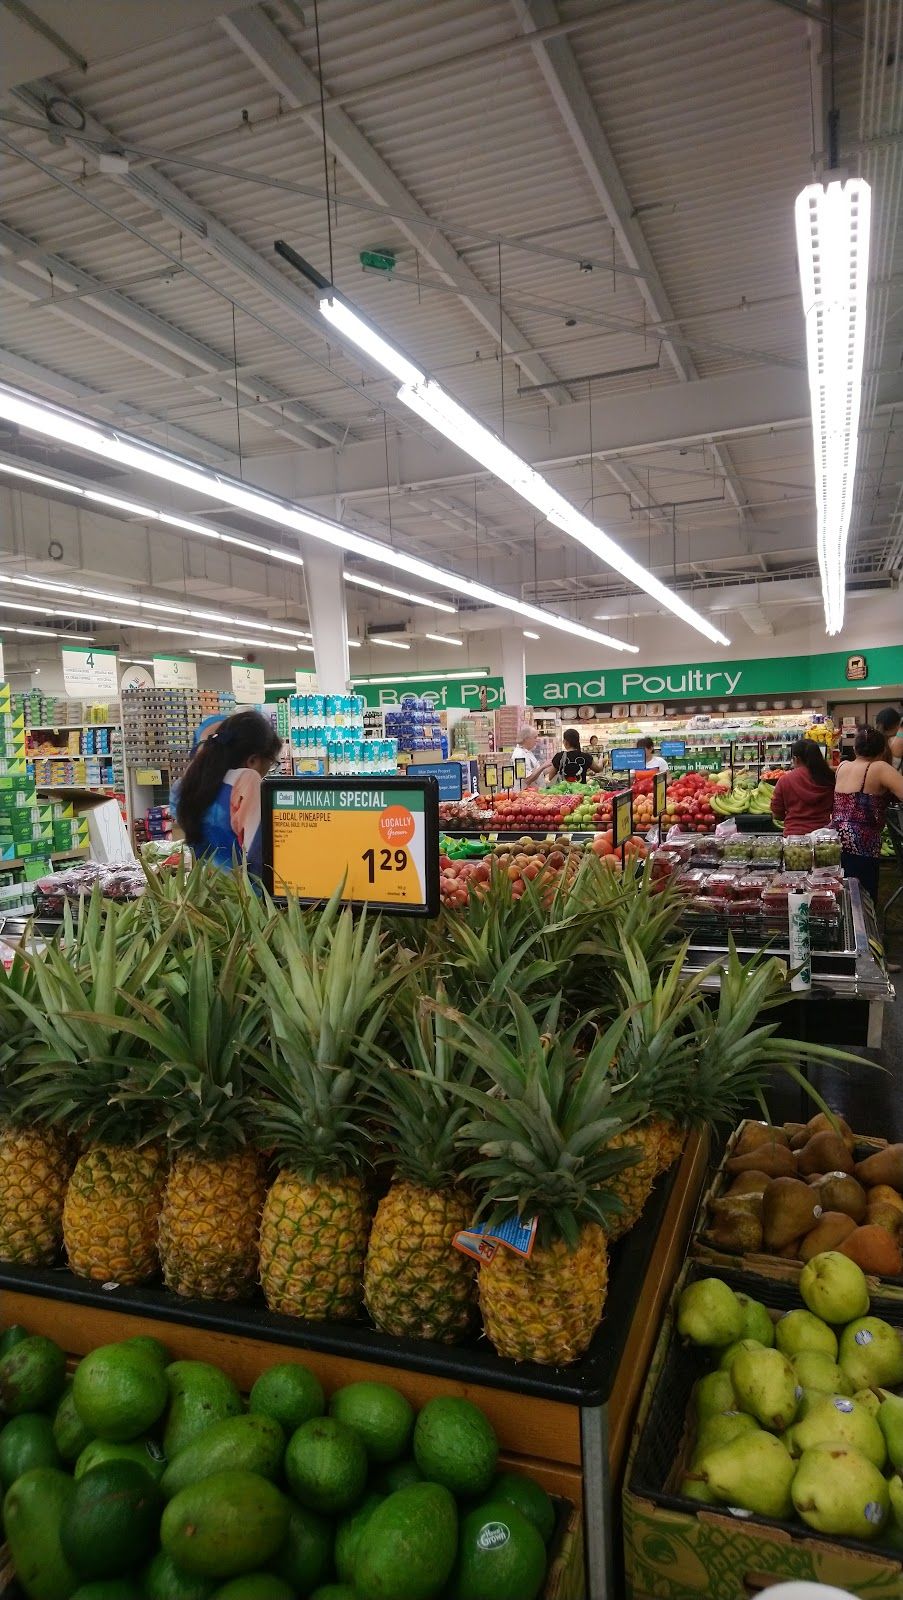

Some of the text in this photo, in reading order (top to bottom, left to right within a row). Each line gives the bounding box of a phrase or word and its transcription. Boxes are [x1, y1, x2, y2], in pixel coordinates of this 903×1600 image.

[86, 653, 94, 668] 4
[173, 663, 179, 673] 3
[246, 670, 251, 678] 2
[543, 676, 605, 700] and
[622, 670, 742, 695] Poultry
[687, 762, 693, 770] in
[339, 791, 388, 807] SPECIAL
[298, 813, 331, 822] PINEAPPLE
[381, 816, 411, 828] LOCALLY
[386, 827, 408, 839] Grown
